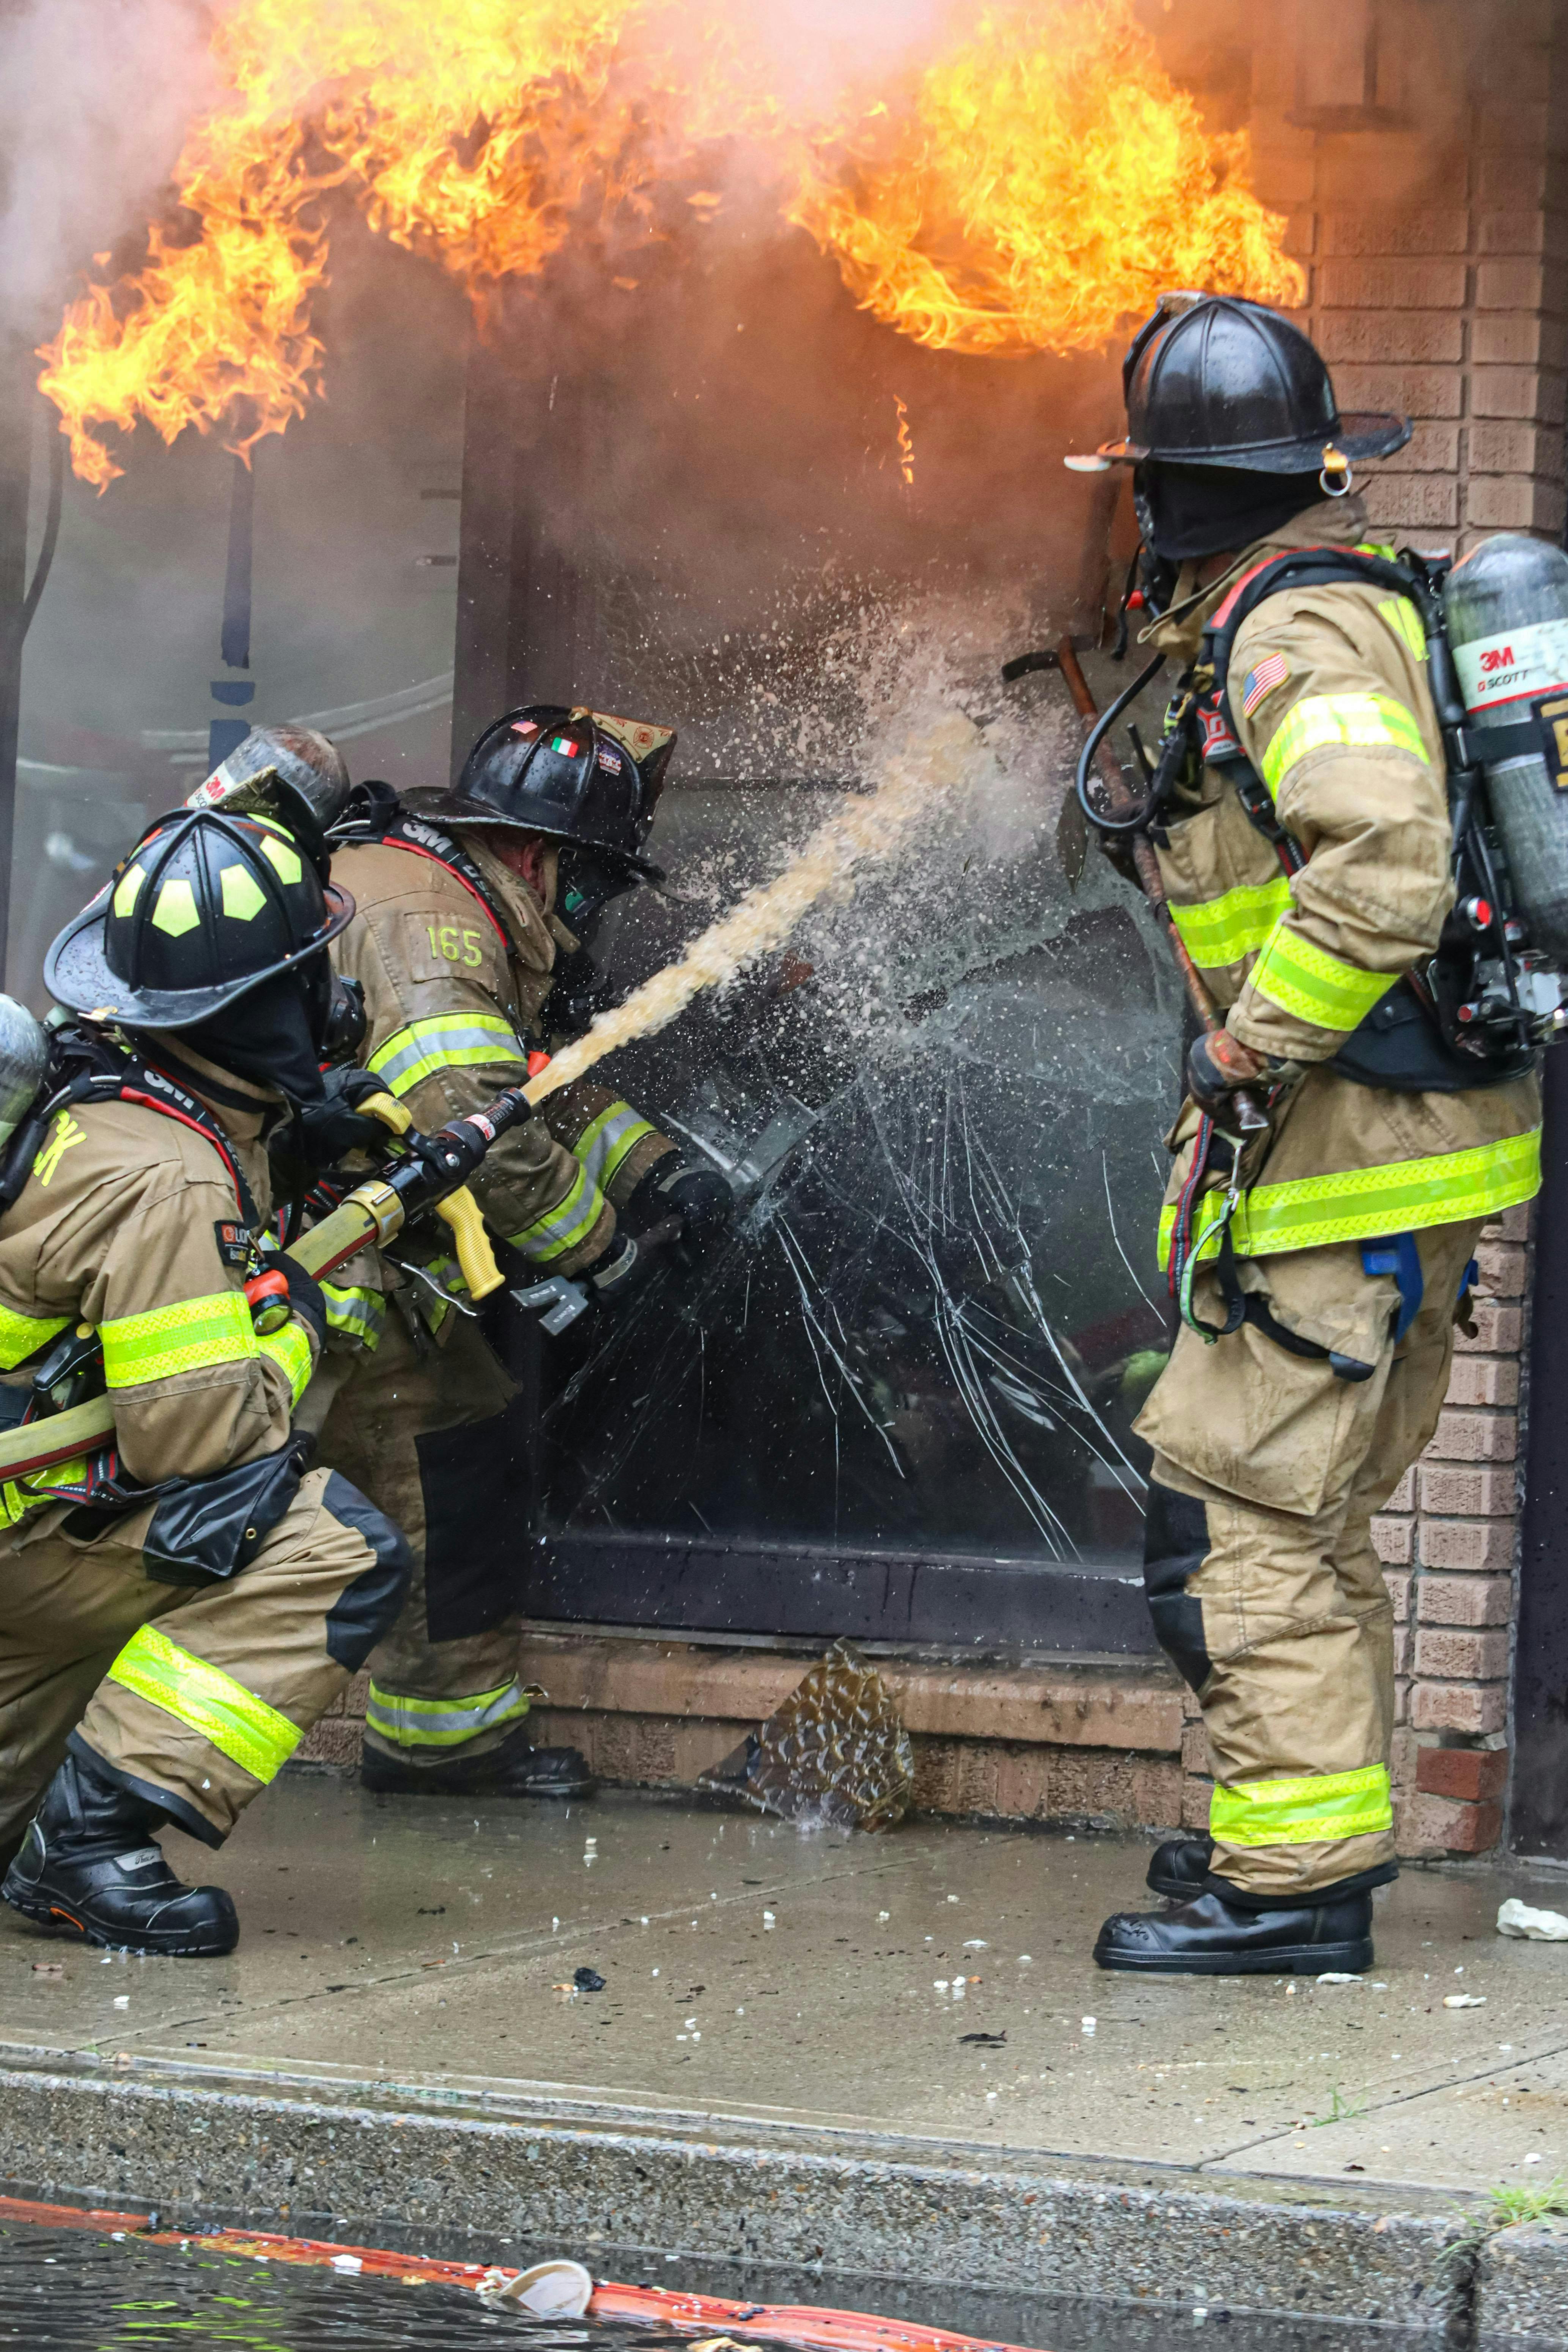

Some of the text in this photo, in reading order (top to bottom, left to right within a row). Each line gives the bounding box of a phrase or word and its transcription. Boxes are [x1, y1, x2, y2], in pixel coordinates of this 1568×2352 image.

[1480, 646, 1514, 672] 3M
[1487, 670, 1529, 690] SCOTT
[196, 793, 207, 808] SCO
[206, 775, 225, 801] 3M
[402, 820, 453, 854] 3M
[426, 926, 482, 967] 165
